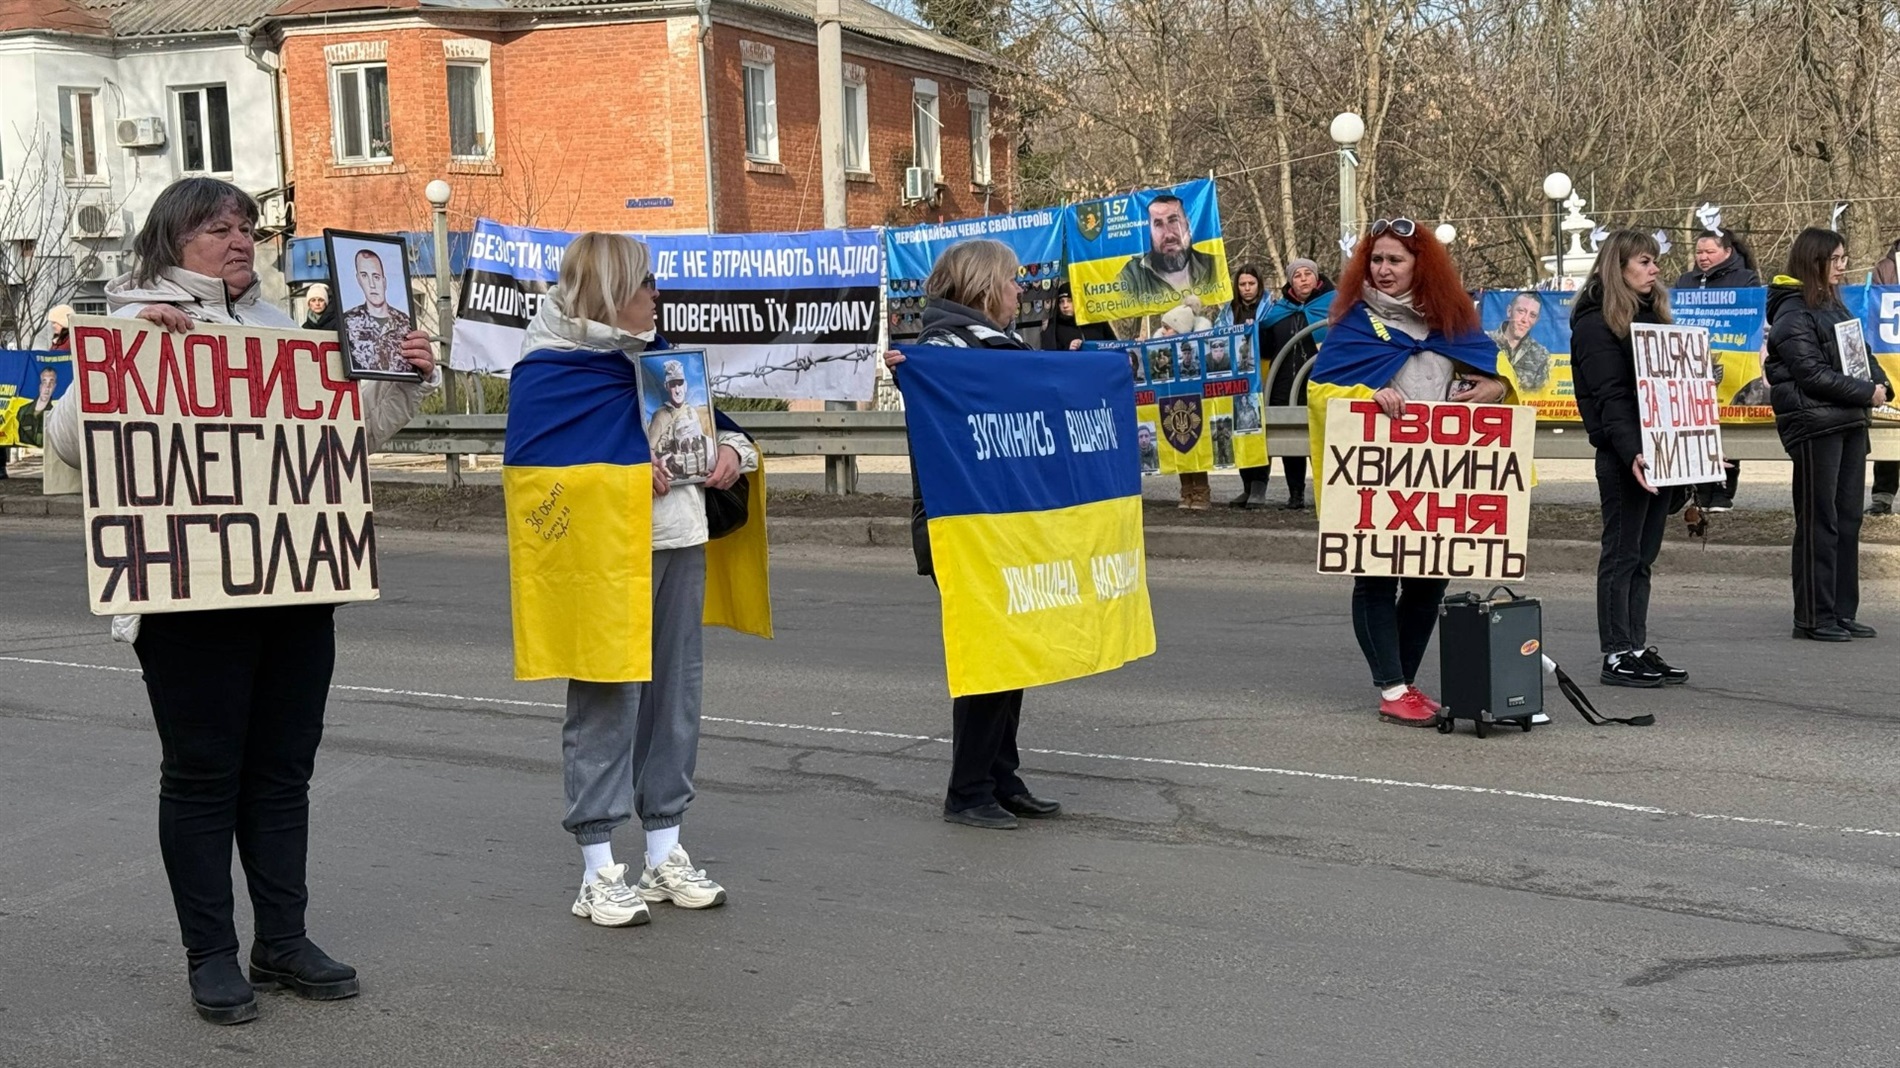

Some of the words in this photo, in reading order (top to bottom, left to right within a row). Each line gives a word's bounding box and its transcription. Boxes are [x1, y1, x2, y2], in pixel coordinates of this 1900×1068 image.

[1104, 199, 1128, 216] 157
[1107, 215, 1128, 223] ОКРЕМА
[959, 222, 987, 237] ЧЕКАЄ
[988, 215, 1018, 233] СВОЇХ
[1108, 230, 1131, 239] БРИГАДА
[655, 251, 678, 280] ДЕ
[683, 251, 708, 278] НЕ
[712, 248, 813, 278] ВТРАЧАЮТЬ
[817, 245, 878, 277] НАДІЮ
[1086, 296, 1135, 314] Євгеній
[1675, 291, 1736, 305] ЛЕМЕШКО
[1695, 308, 1757, 316] Володимирович
[663, 303, 764, 332] ПОВЕРНІТЬ
[765, 298, 789, 332] ЇХ
[792, 301, 875, 334] ДОДОМУ
[1675, 317, 1715, 327] 27.12.1987
[74, 326, 361, 420] ВКЛОНИСЯ
[1204, 379, 1249, 397] ВІРИМО
[1639, 379, 1661, 427] ЗА
[1747, 406, 1772, 417] СЕНС
[967, 411, 1055, 460] ЗУПИНИСЬ
[1350, 401, 1513, 448] ТВОЯ
[84, 420, 371, 508] ПОЛЕГЛИМ
[1327, 445, 1524, 492] ХВИЛИНА
[1650, 429, 1720, 479] ЖИТТЯ
[525, 510, 544, 534] 36
[1354, 487, 1508, 535] ЇХНЯ
[91, 511, 378, 602] ЯНГОЛАМ
[1318, 530, 1526, 579] ВІЧНІСТЬ
[1002, 560, 1082, 615] ХВИЛИНА
